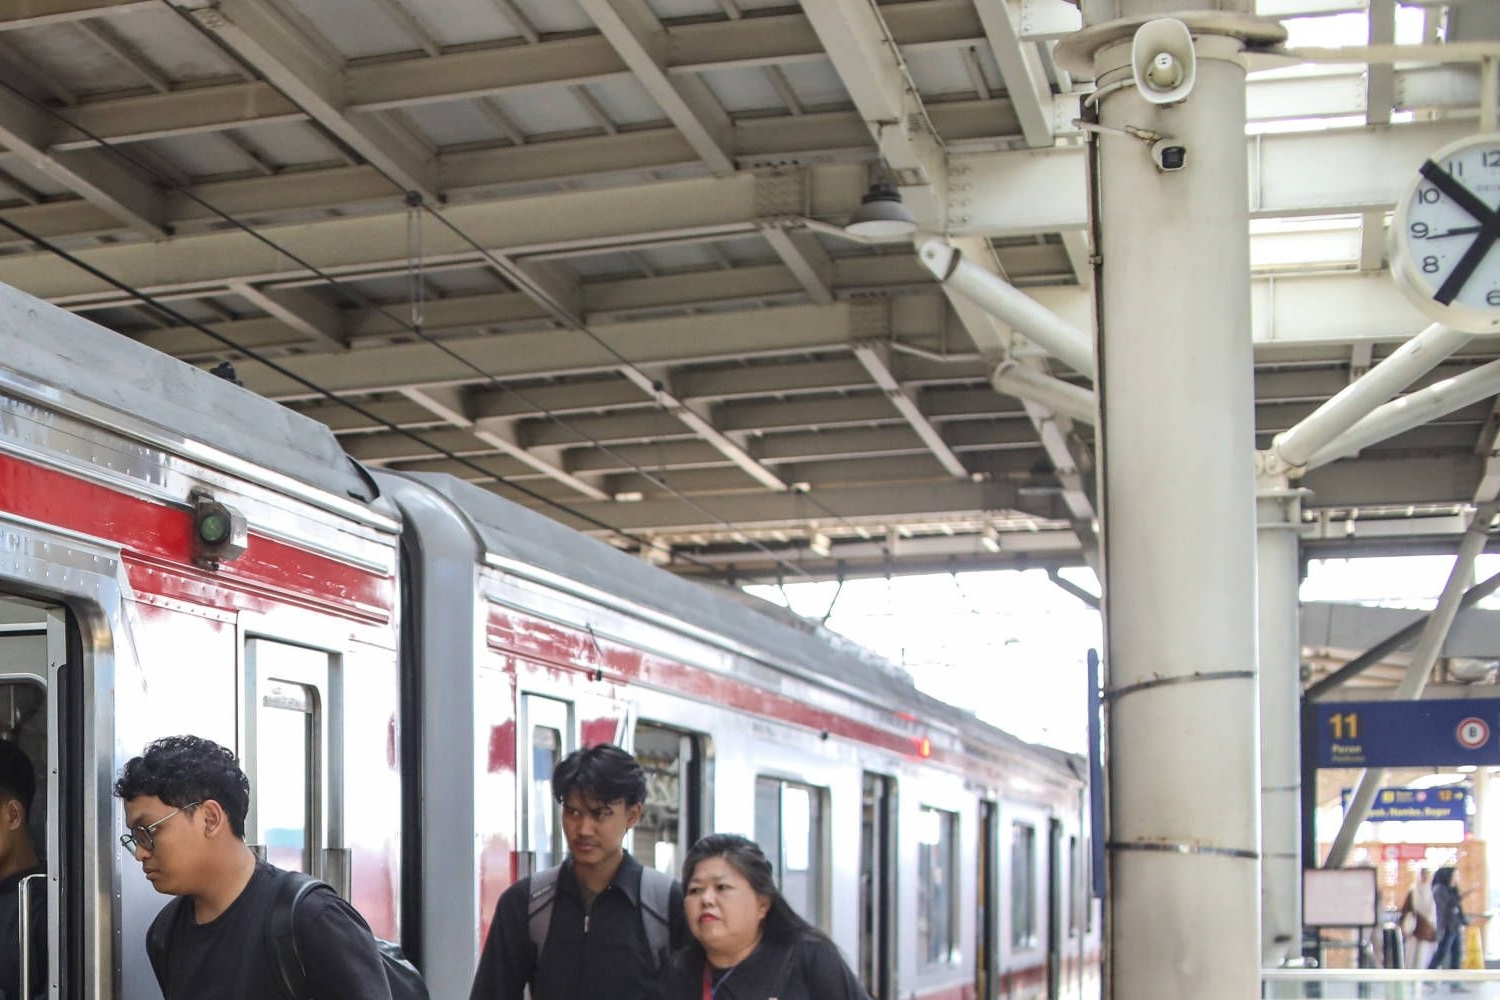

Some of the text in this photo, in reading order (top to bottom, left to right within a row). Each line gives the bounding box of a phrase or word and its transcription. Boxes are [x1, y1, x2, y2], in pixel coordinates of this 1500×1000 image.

[1482, 151, 1500, 168] 12
[1448, 161, 1463, 177] 11
[1418, 187, 1440, 205] 10
[1411, 222, 1429, 239] 9
[1422, 255, 1440, 273] 8
[1486, 289, 1500, 306] 6
[1329, 712, 1358, 740] 11
